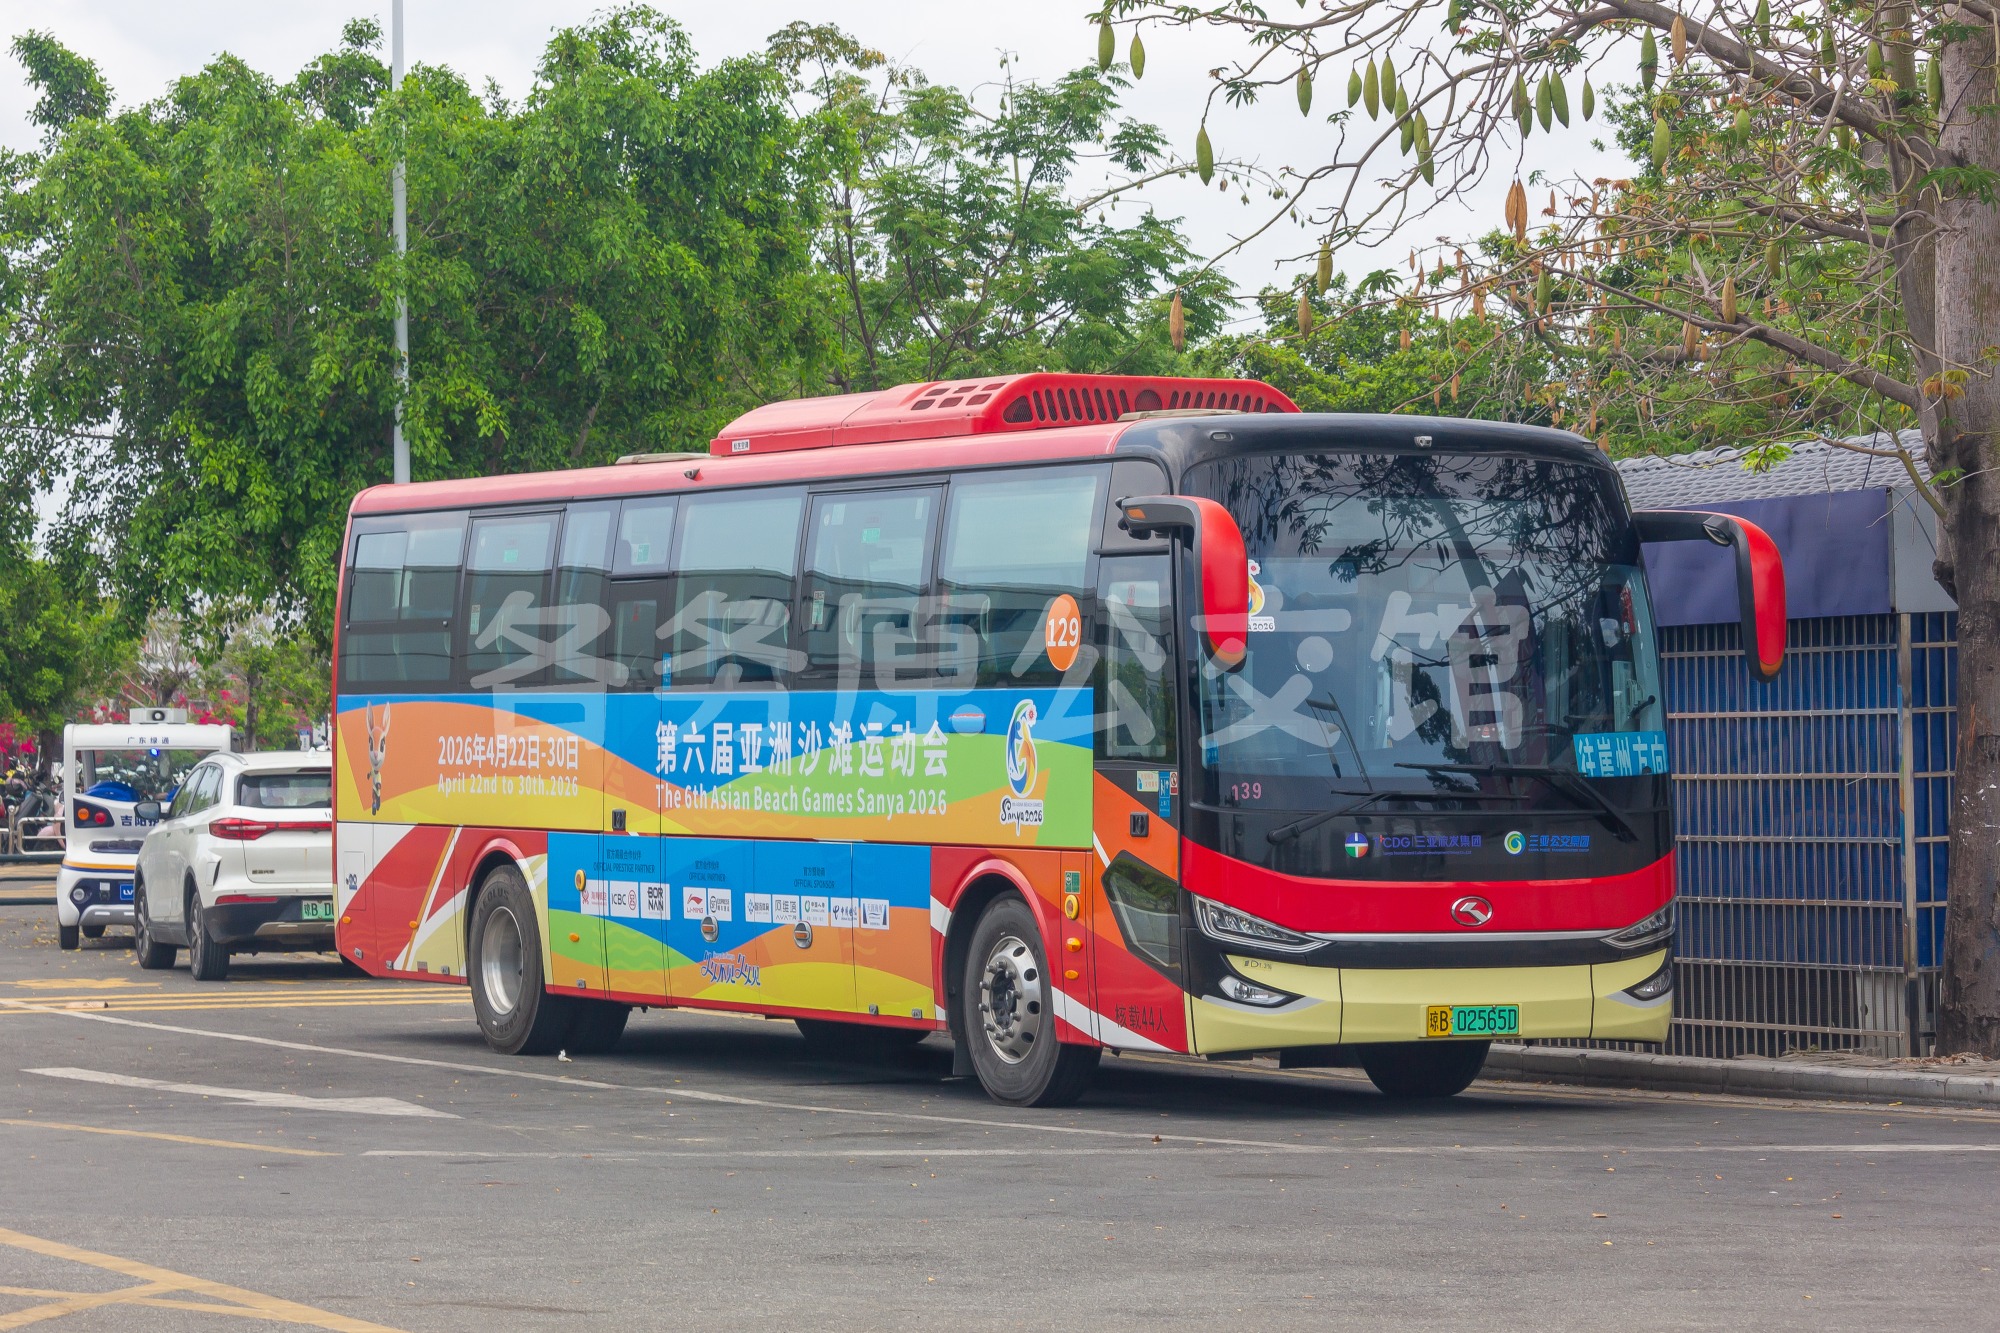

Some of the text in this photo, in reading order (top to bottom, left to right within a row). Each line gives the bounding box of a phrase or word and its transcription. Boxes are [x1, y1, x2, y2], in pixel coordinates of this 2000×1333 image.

[1047, 617, 1079, 647] 129
[438, 733, 578, 770] 2026年4月22日-30日
[655, 719, 948, 777] 第六届亚洲沙滩运动会
[1578, 734, 1667, 777] 往崖州方向
[438, 772, 465, 797] April
[470, 773, 497, 794] 22nd
[502, 776, 513, 794] to
[1231, 782, 1262, 800] 139
[655, 783, 947, 821] The 6th Asian Beach Games Sanya 2026
[1529, 835, 1590, 847] 三亚公交集团
[611, 893, 627, 905] ICBC
[1115, 1003, 1169, 1032] 核载44人
[1430, 1009, 1517, 1032] 琼B 02565D
